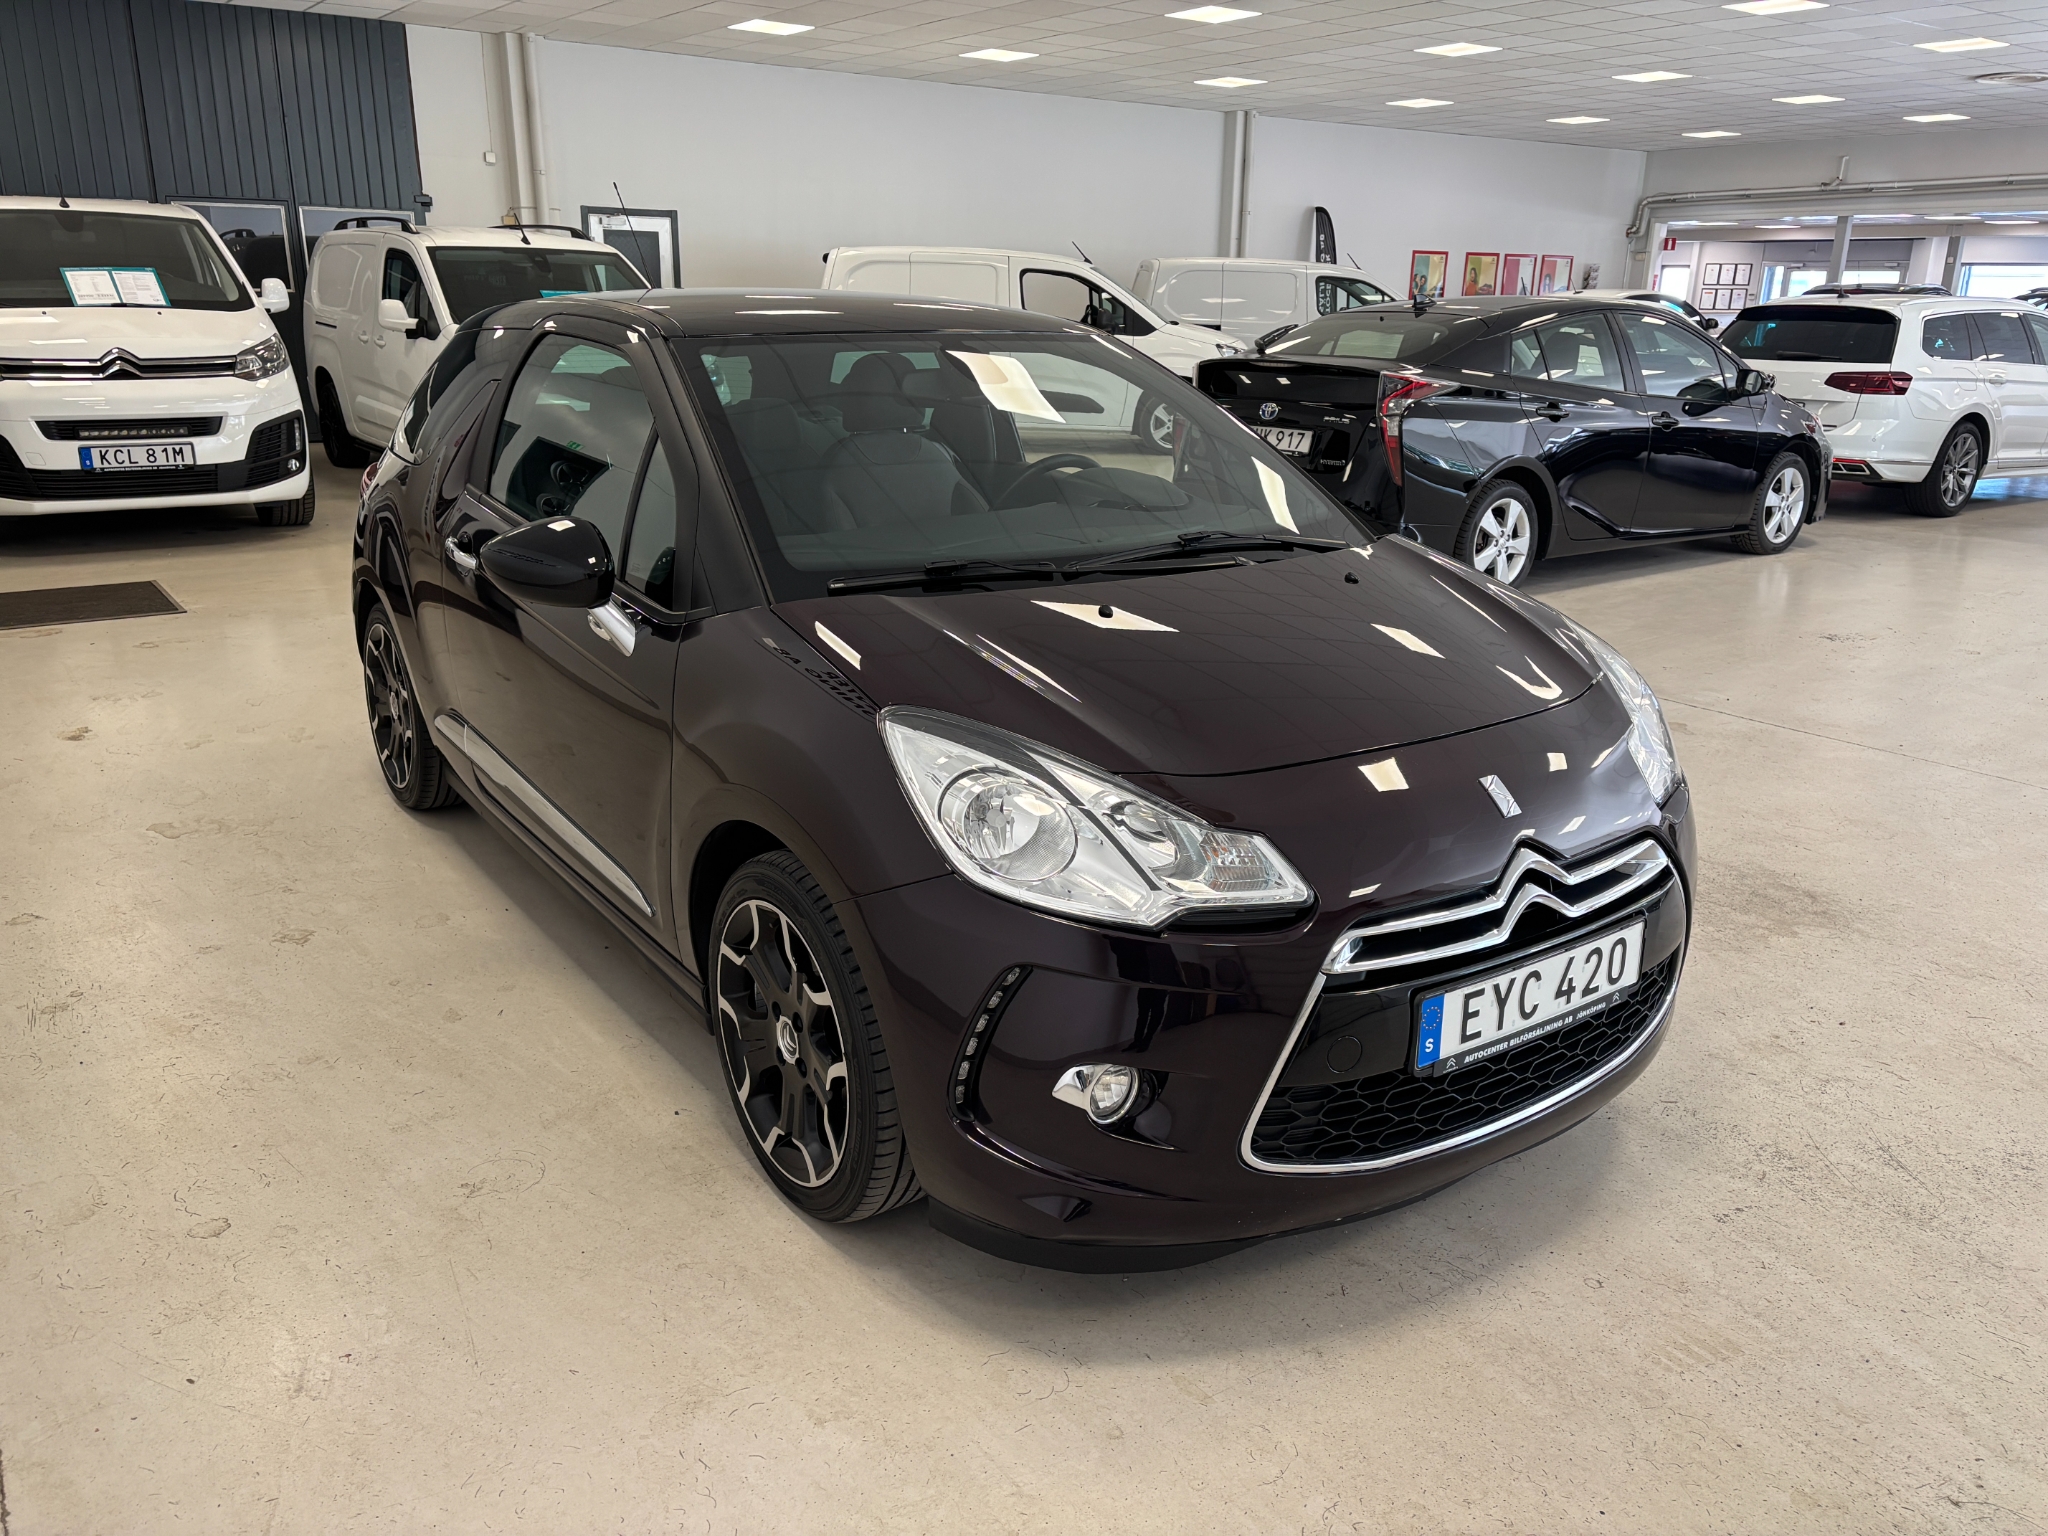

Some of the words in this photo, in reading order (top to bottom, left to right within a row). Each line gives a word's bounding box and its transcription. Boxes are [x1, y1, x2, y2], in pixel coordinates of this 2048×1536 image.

[1275, 430, 1306, 449] 917
[99, 448, 139, 466] KCL
[146, 446, 185, 464] 81M
[1460, 969, 1543, 1045] EYC
[1554, 936, 1628, 1006] 420
[1463, 1041, 1509, 1064] AUTOCENTER
[1509, 1019, 1563, 1046] BILFÖRSÄLJNING
[1564, 1015, 1573, 1025] AB
[1576, 1002, 1607, 1020] JÖNKÖPING
[1424, 1038, 1434, 1053] S
